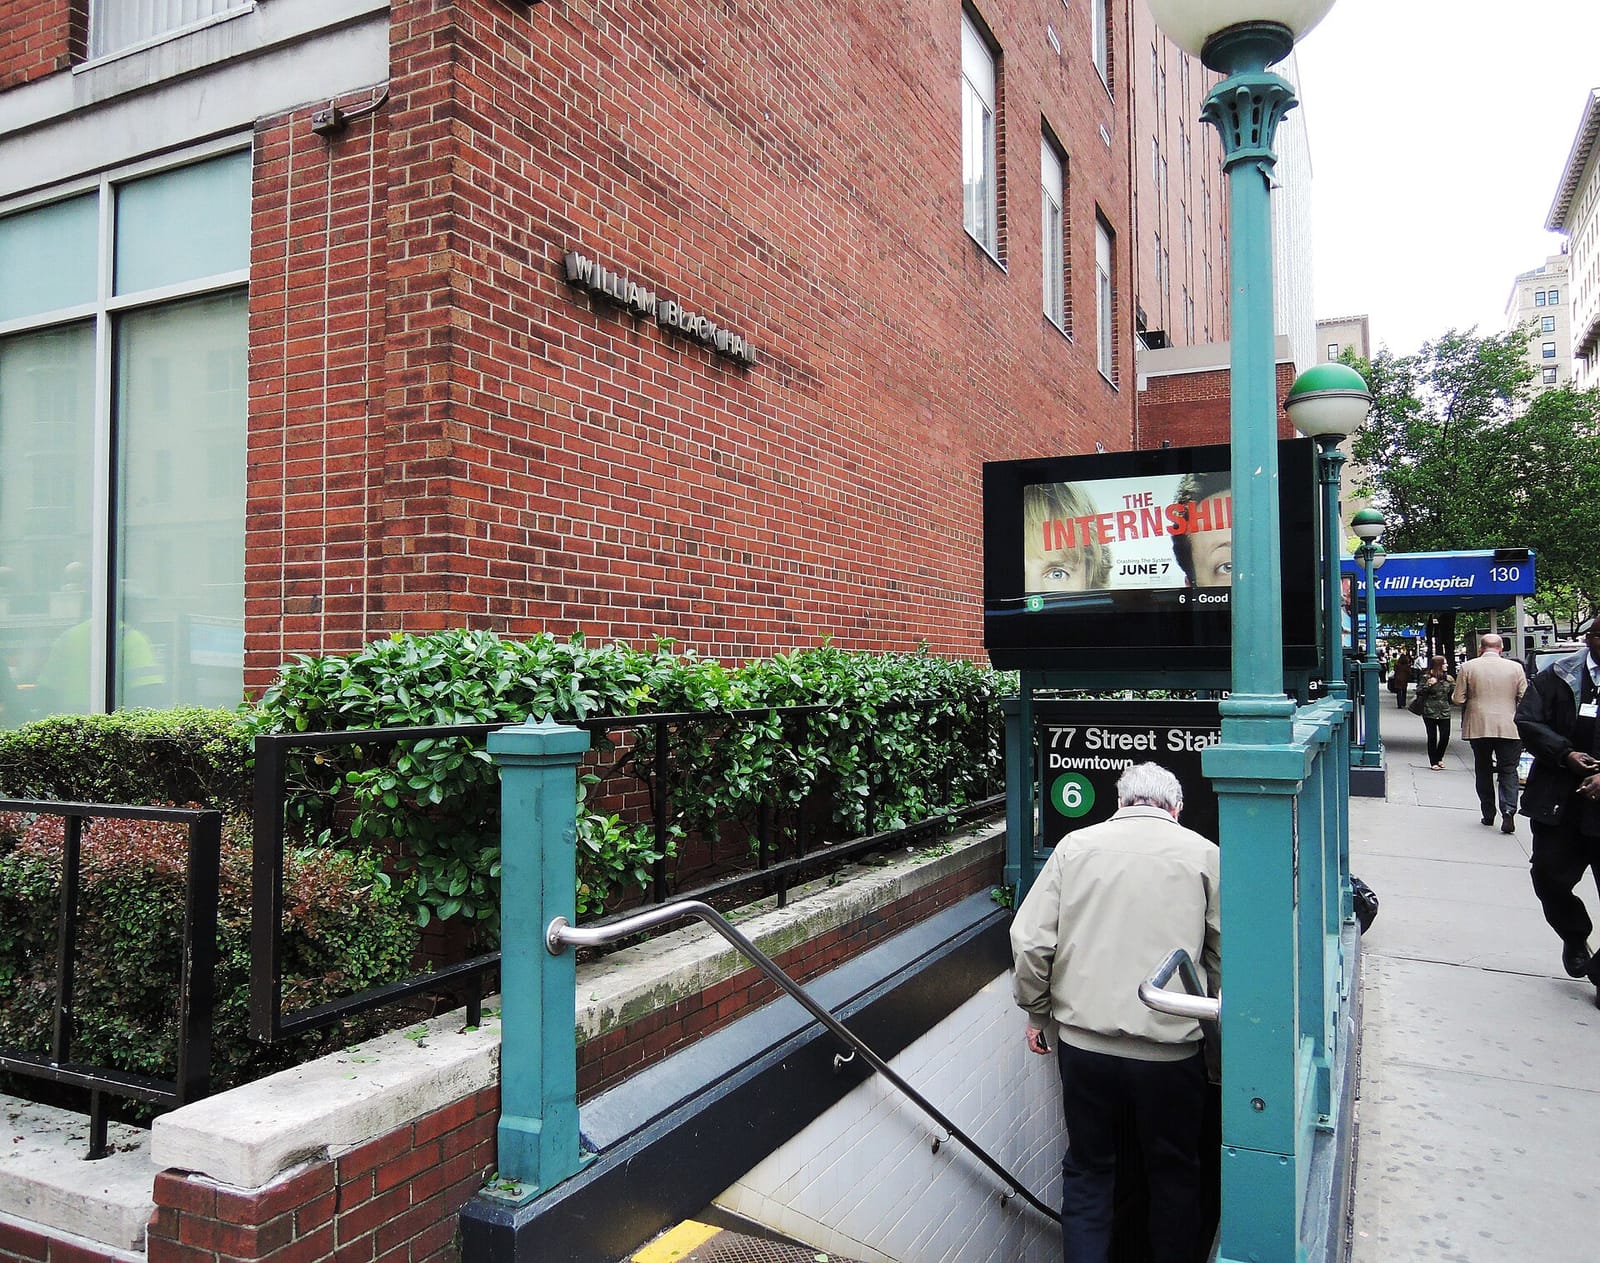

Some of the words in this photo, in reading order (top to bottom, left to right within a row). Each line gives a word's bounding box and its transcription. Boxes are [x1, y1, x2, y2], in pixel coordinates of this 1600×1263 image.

[566, 251, 656, 316] WILLIAM
[659, 300, 718, 346] BLACK
[1122, 491, 1153, 509] THE
[1119, 563, 1158, 576] JUNE
[1161, 563, 1170, 575] 7
[1489, 567, 1520, 582] 130
[1384, 576, 1410, 589] Hill
[1412, 575, 1475, 591] Hospital
[1032, 598, 1039, 609] 6
[1179, 594, 1186, 604] 6
[1198, 593, 1229, 604] Good
[1049, 728, 1077, 748] 77
[1085, 728, 1157, 750] Street
[1050, 754, 1134, 770] Downtown
[1062, 782, 1082, 808] 6
